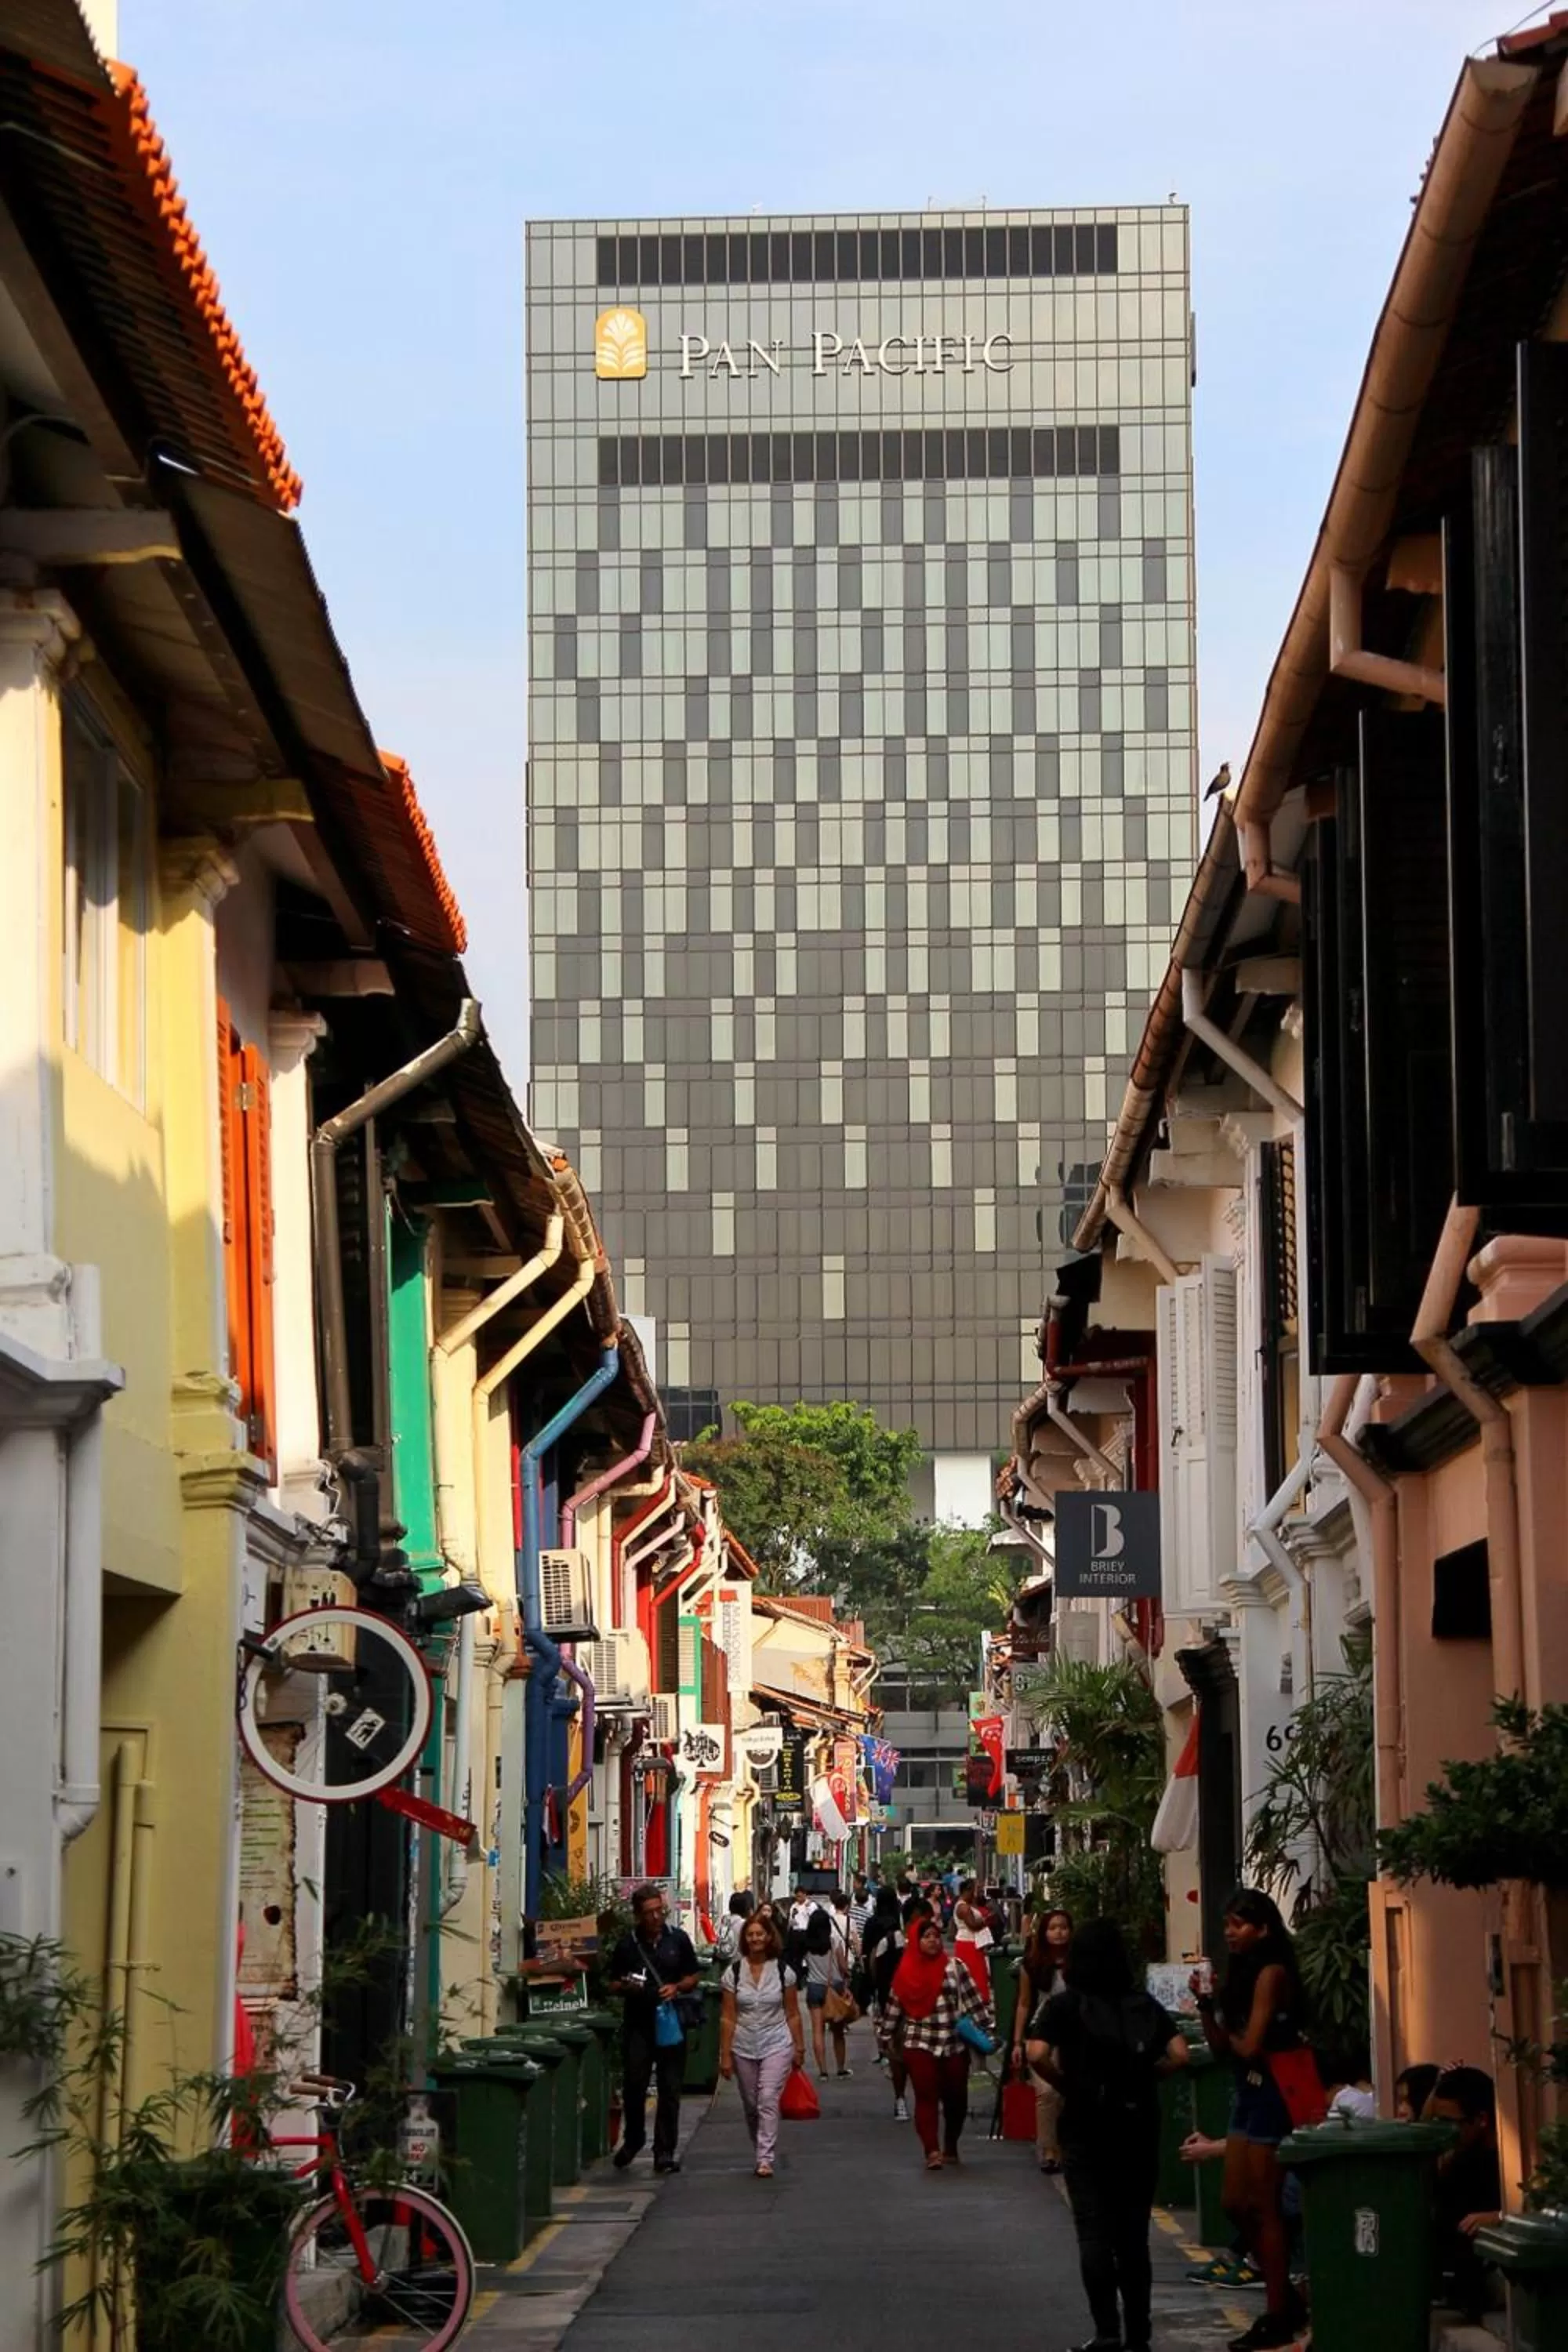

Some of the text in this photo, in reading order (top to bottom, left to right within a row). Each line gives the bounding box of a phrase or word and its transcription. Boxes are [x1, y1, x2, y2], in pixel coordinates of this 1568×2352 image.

[678, 332, 1015, 379] PAN PACIFIC
[1091, 1504, 1125, 1558] B
[1079, 1573, 1136, 1584] INTERIOR
[1091, 1561, 1125, 1572] BRIEY
